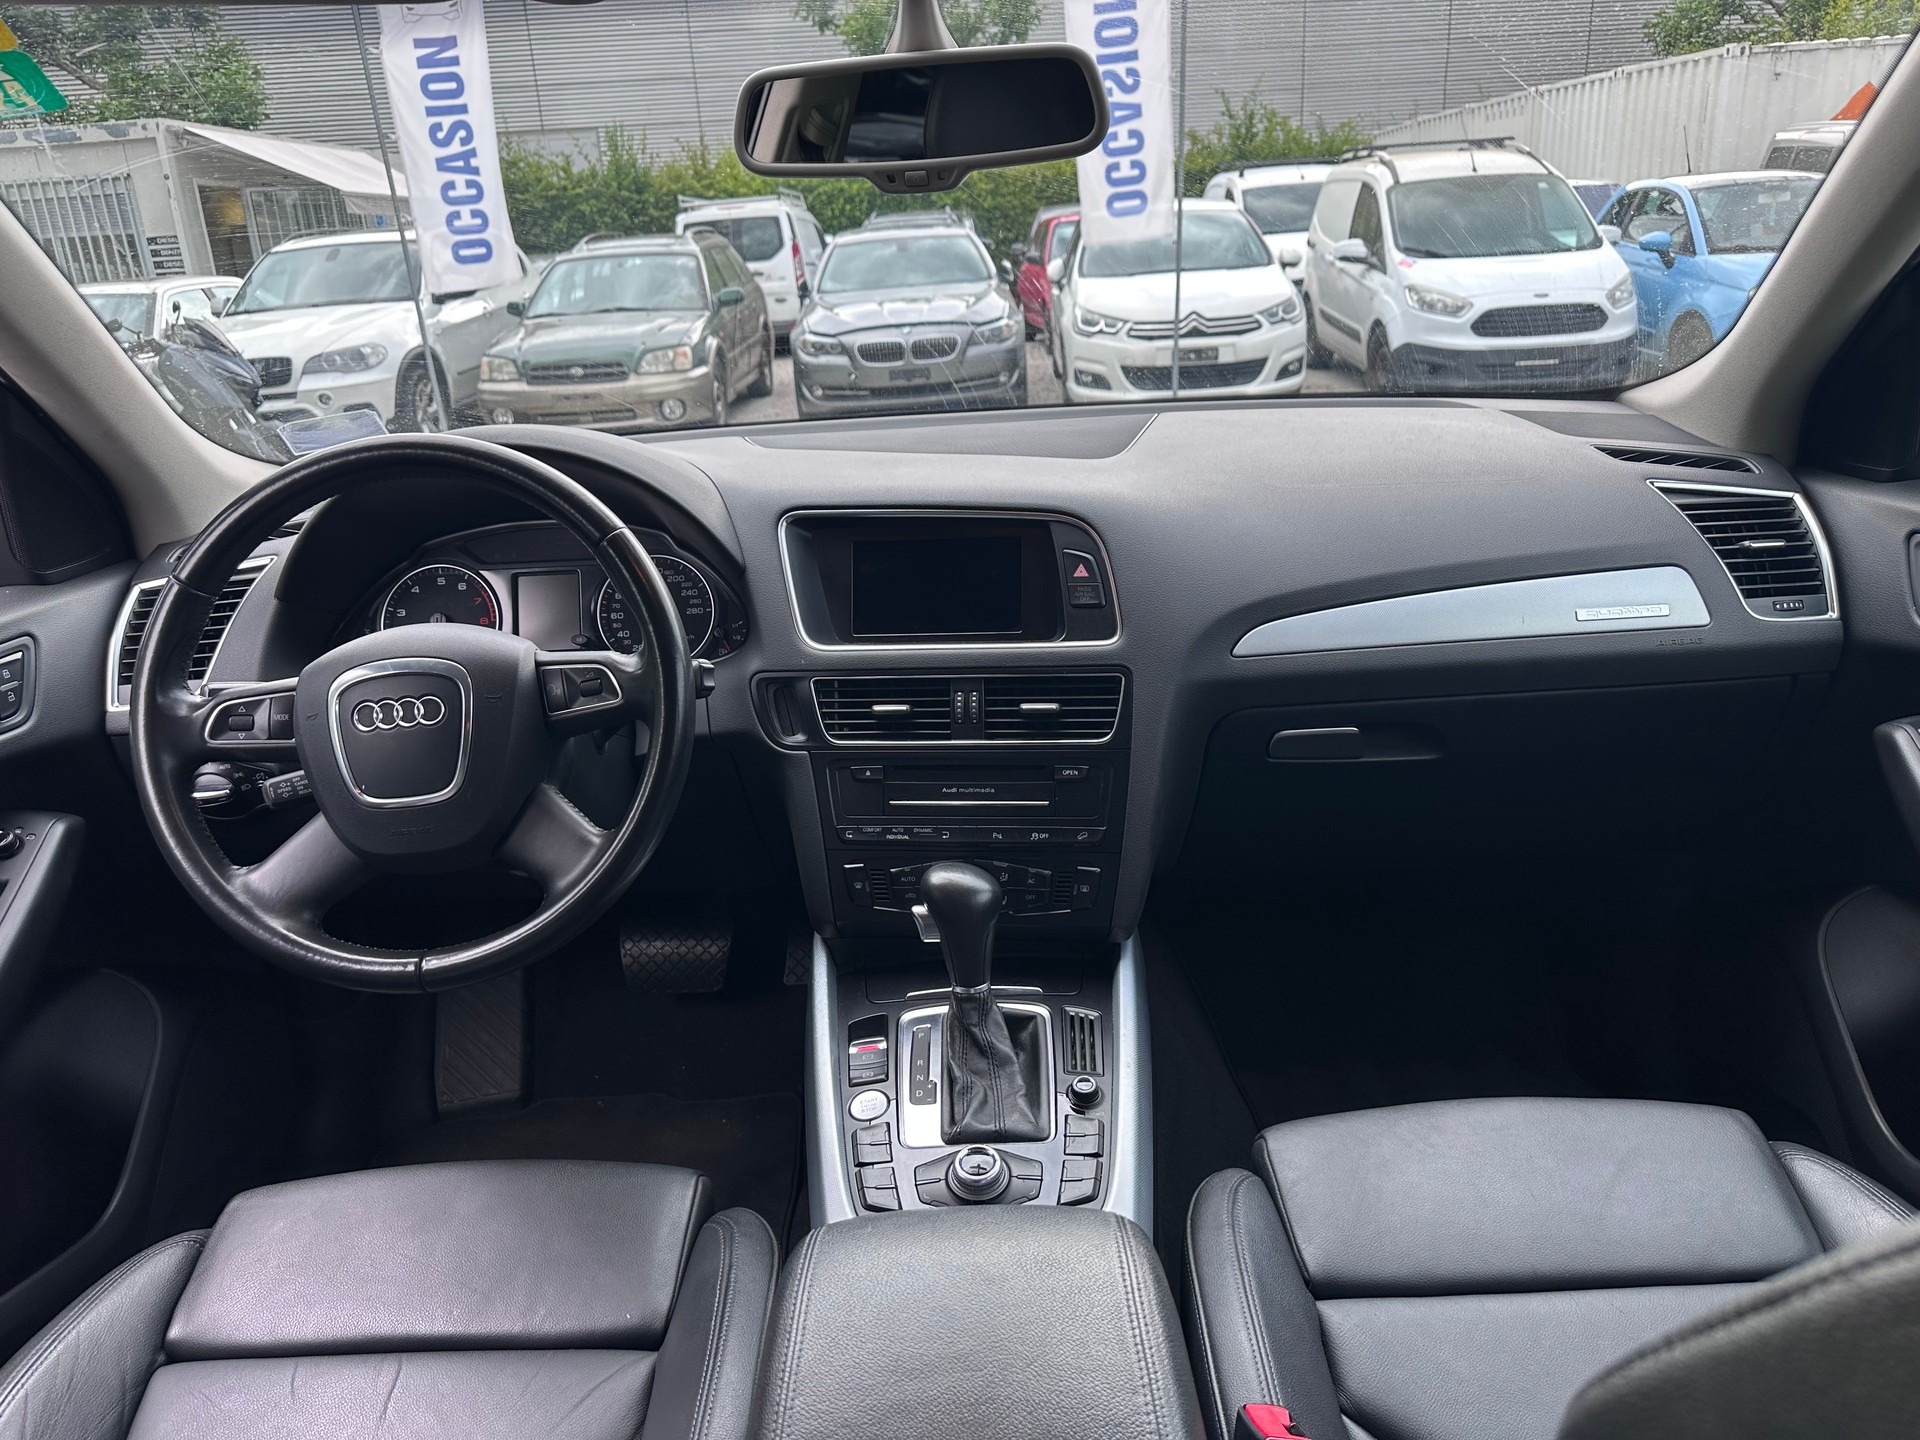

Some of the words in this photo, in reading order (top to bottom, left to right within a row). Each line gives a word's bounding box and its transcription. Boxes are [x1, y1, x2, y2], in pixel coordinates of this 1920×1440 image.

[412, 35, 493, 265] OCCASION
[437, 577, 446, 585] 5
[667, 575, 685, 583] 200
[681, 589, 698, 597] 240
[396, 609, 406, 617] 3
[610, 612, 624, 620] 60
[1586, 606, 1662, 618] quattro
[480, 617, 489, 625] 8
[617, 630, 630, 638] 40
[1656, 637, 1704, 647] AIRBAG
[273, 713, 290, 721] MODE
[859, 1097, 878, 1105] START
